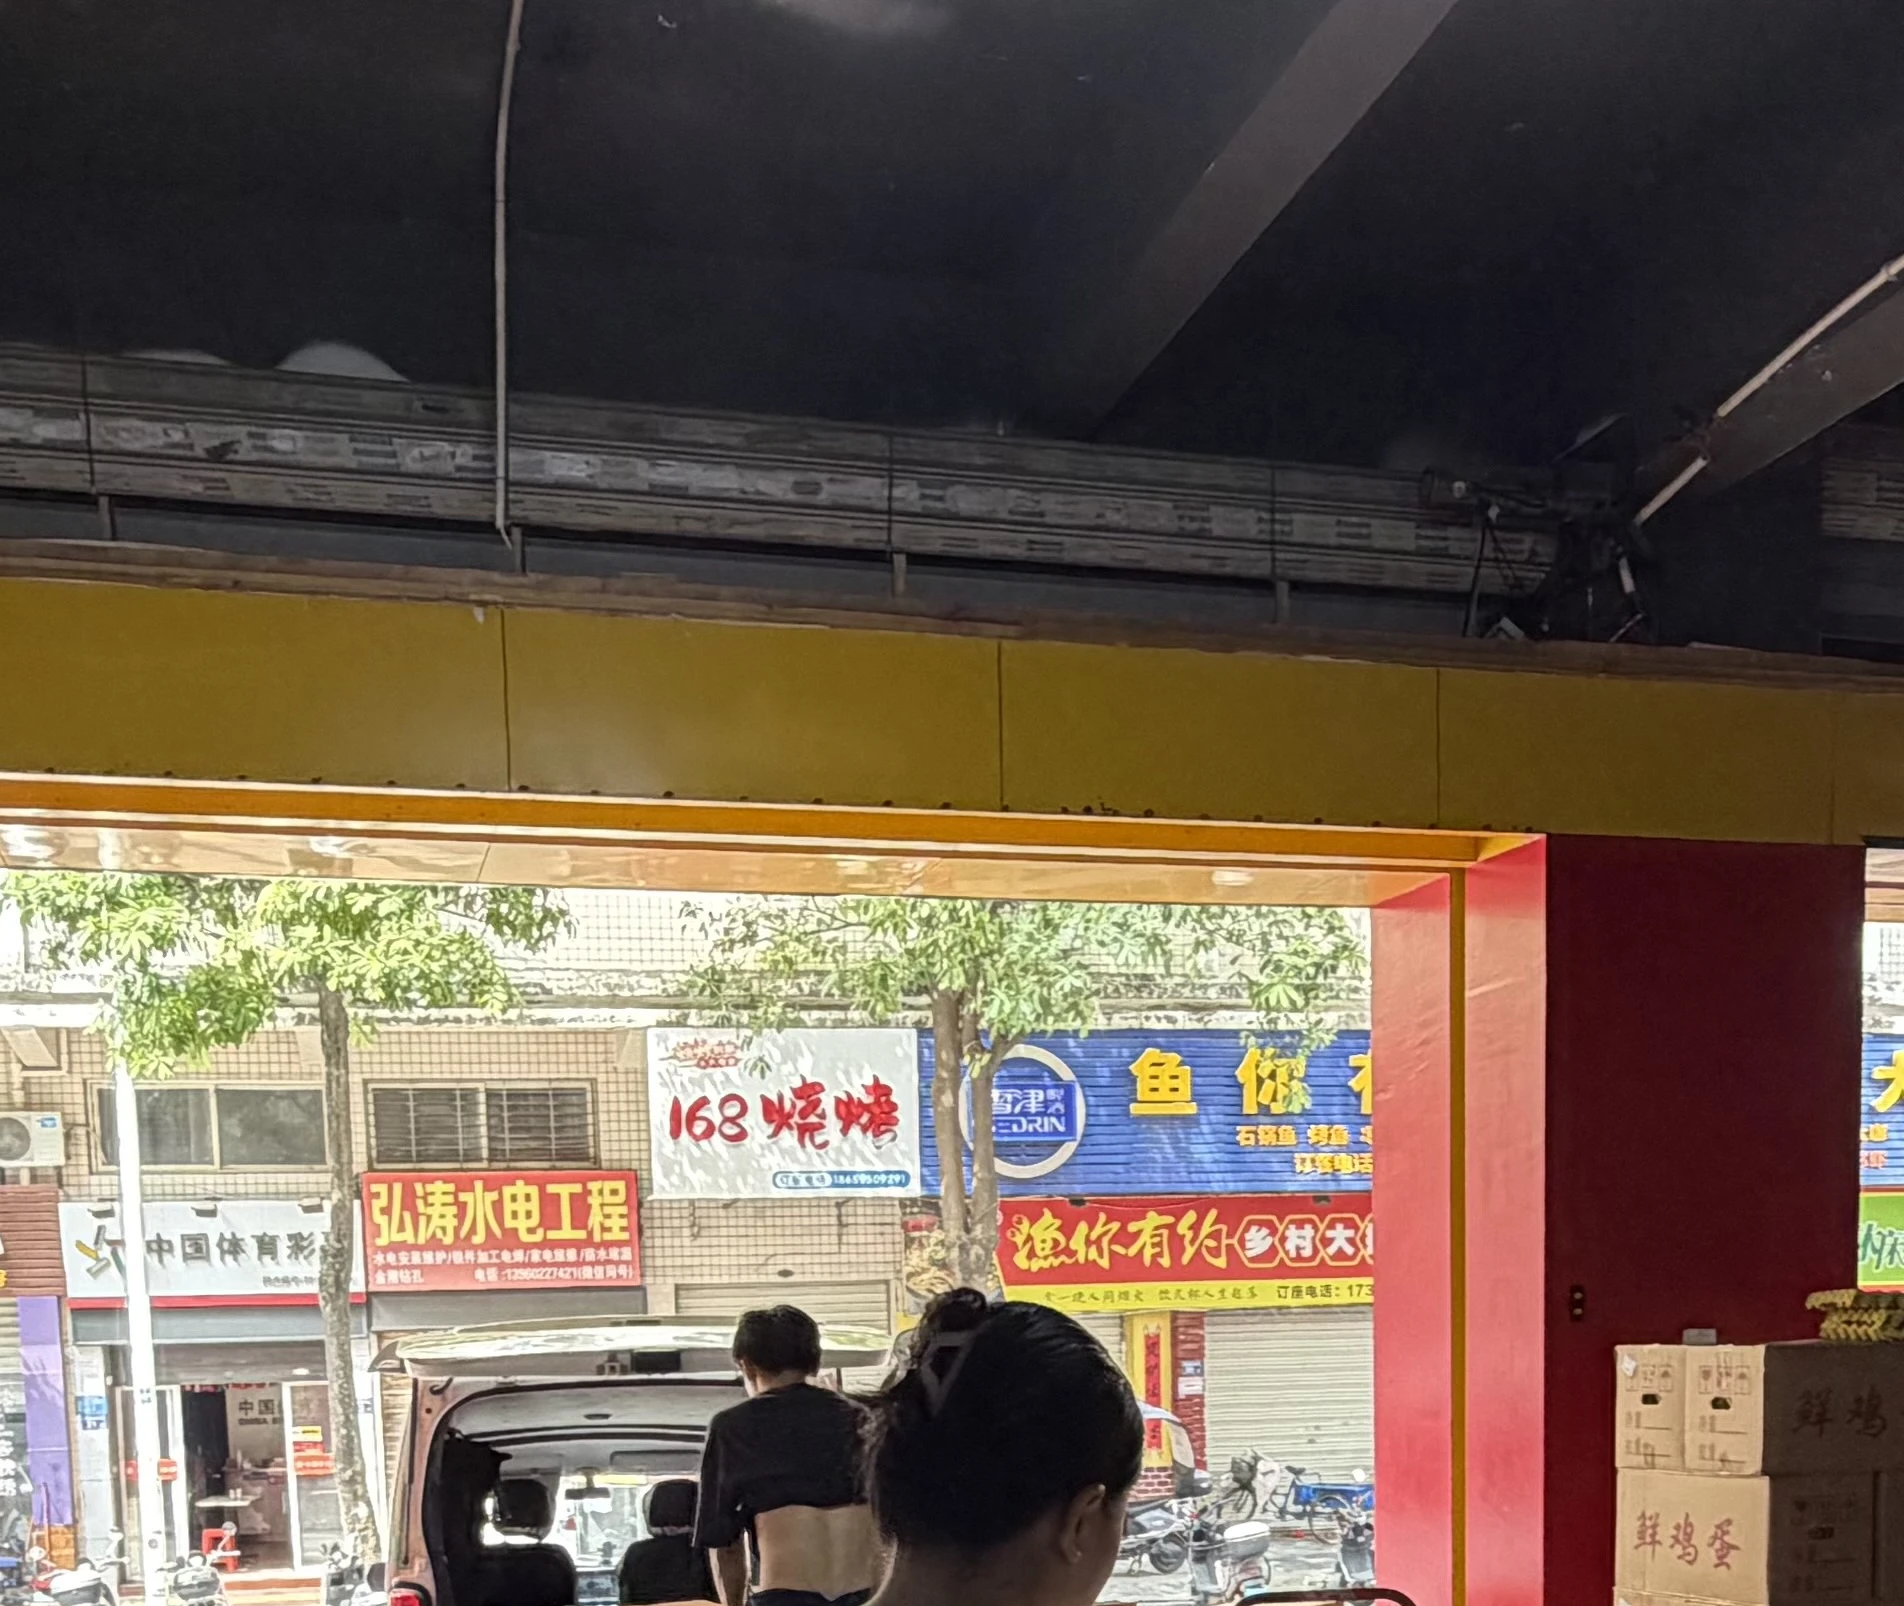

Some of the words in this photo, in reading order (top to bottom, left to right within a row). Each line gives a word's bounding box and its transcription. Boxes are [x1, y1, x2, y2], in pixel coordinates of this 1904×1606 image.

[1236, 1125, 1297, 1146] 石锅鱼
[369, 1180, 631, 1246] 弘涛水电工程
[145, 1231, 333, 1266] 中国体育彩
[1243, 1224, 1373, 1259] 乡村大
[1634, 1510, 1742, 1571] 鲜鸡蛋
